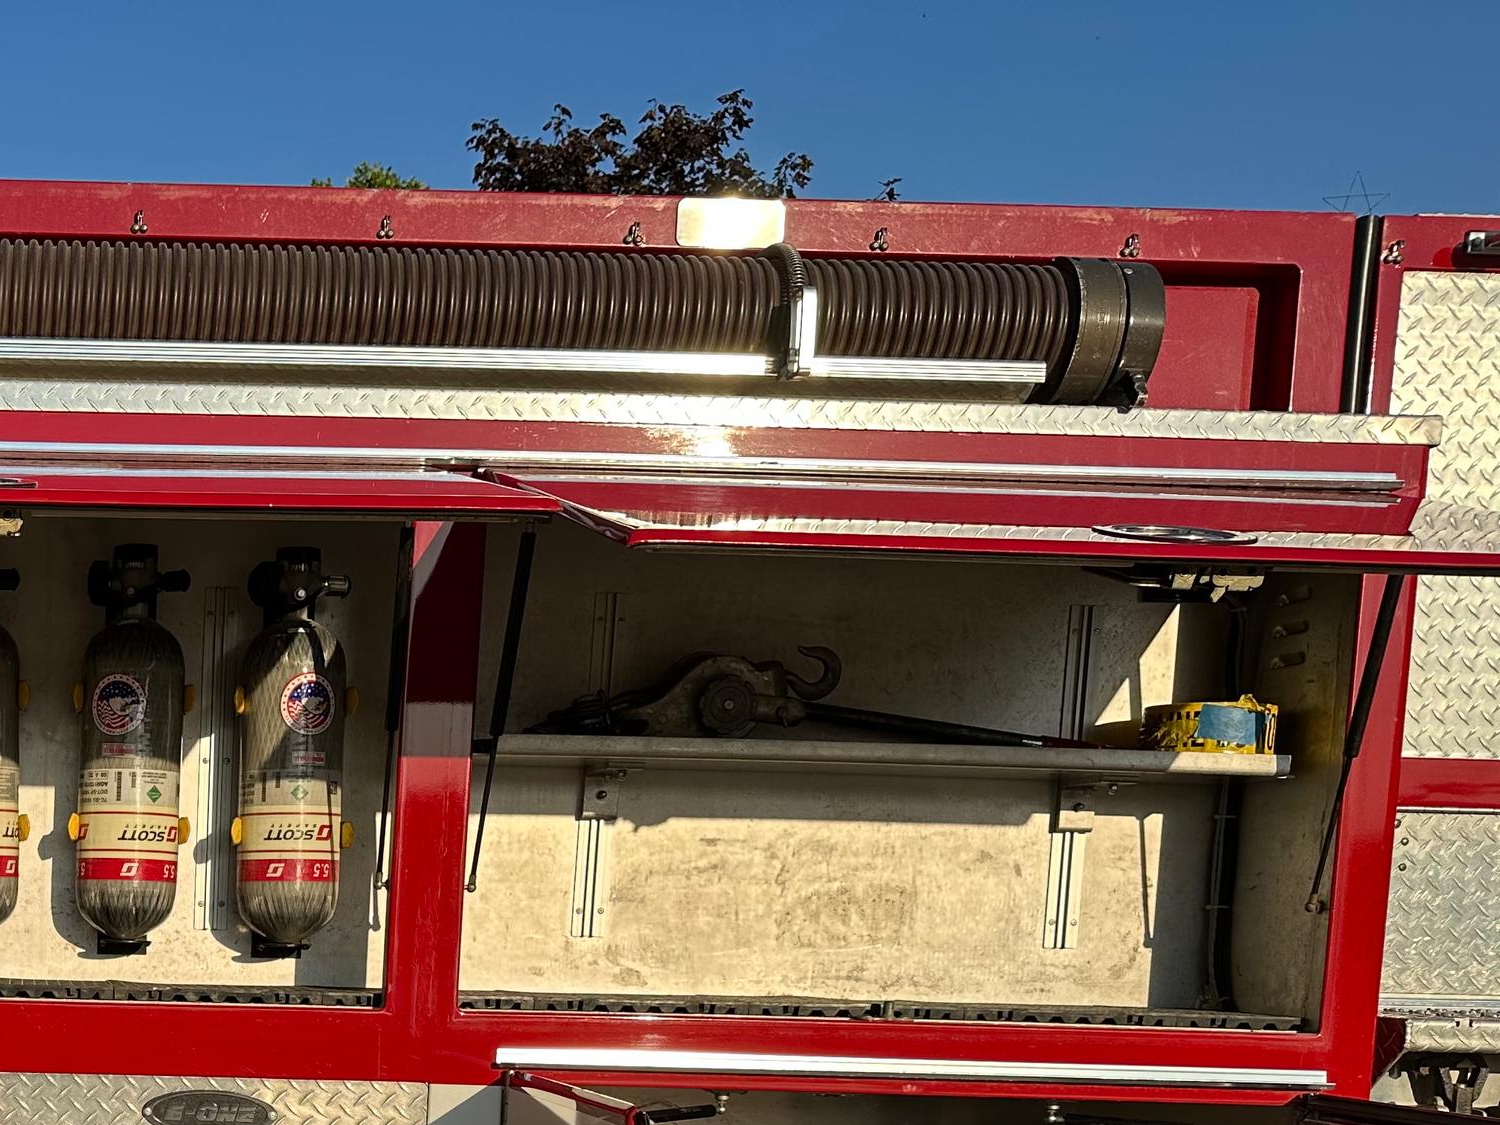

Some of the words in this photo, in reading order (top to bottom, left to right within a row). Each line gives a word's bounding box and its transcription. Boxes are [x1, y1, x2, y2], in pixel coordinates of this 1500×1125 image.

[117, 829, 166, 842] SCOTT
[263, 829, 315, 841] SCOTT
[163, 864, 175, 879] 5.5
[312, 863, 330, 878] 5.5
